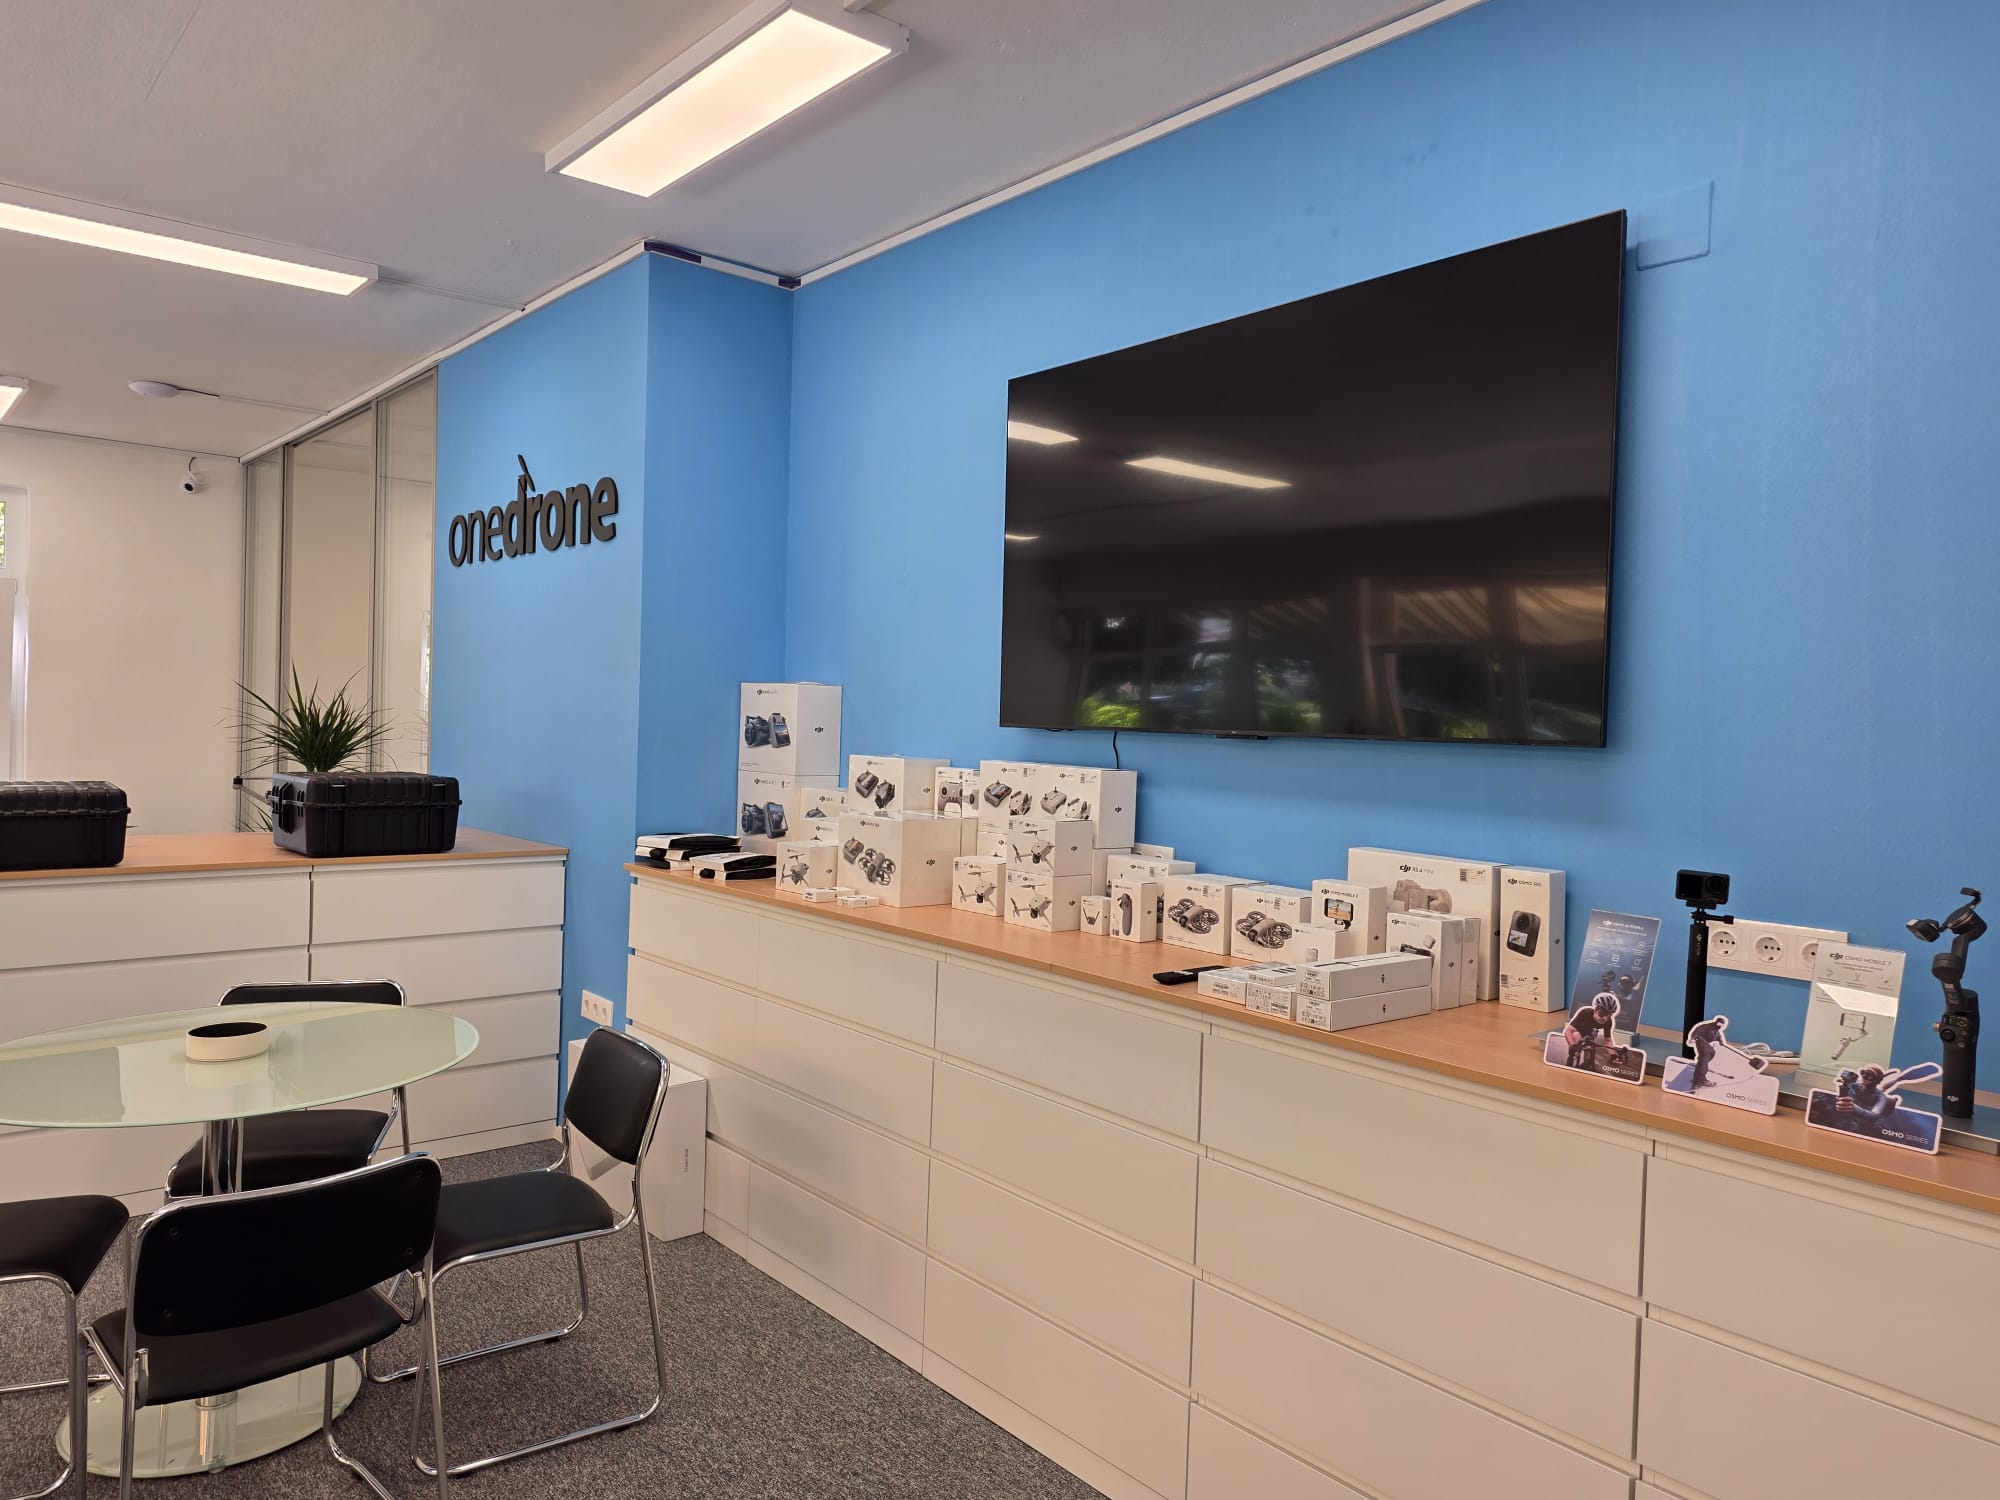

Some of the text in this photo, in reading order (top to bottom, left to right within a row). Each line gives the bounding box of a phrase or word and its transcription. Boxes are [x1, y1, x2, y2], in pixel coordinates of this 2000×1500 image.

[449, 474, 618, 567] onedrone
[1602, 1065, 1620, 1074] OSMO
[1725, 1092, 1746, 1102] OSMO
[1881, 1128, 1929, 1145] OSMO SERIES
